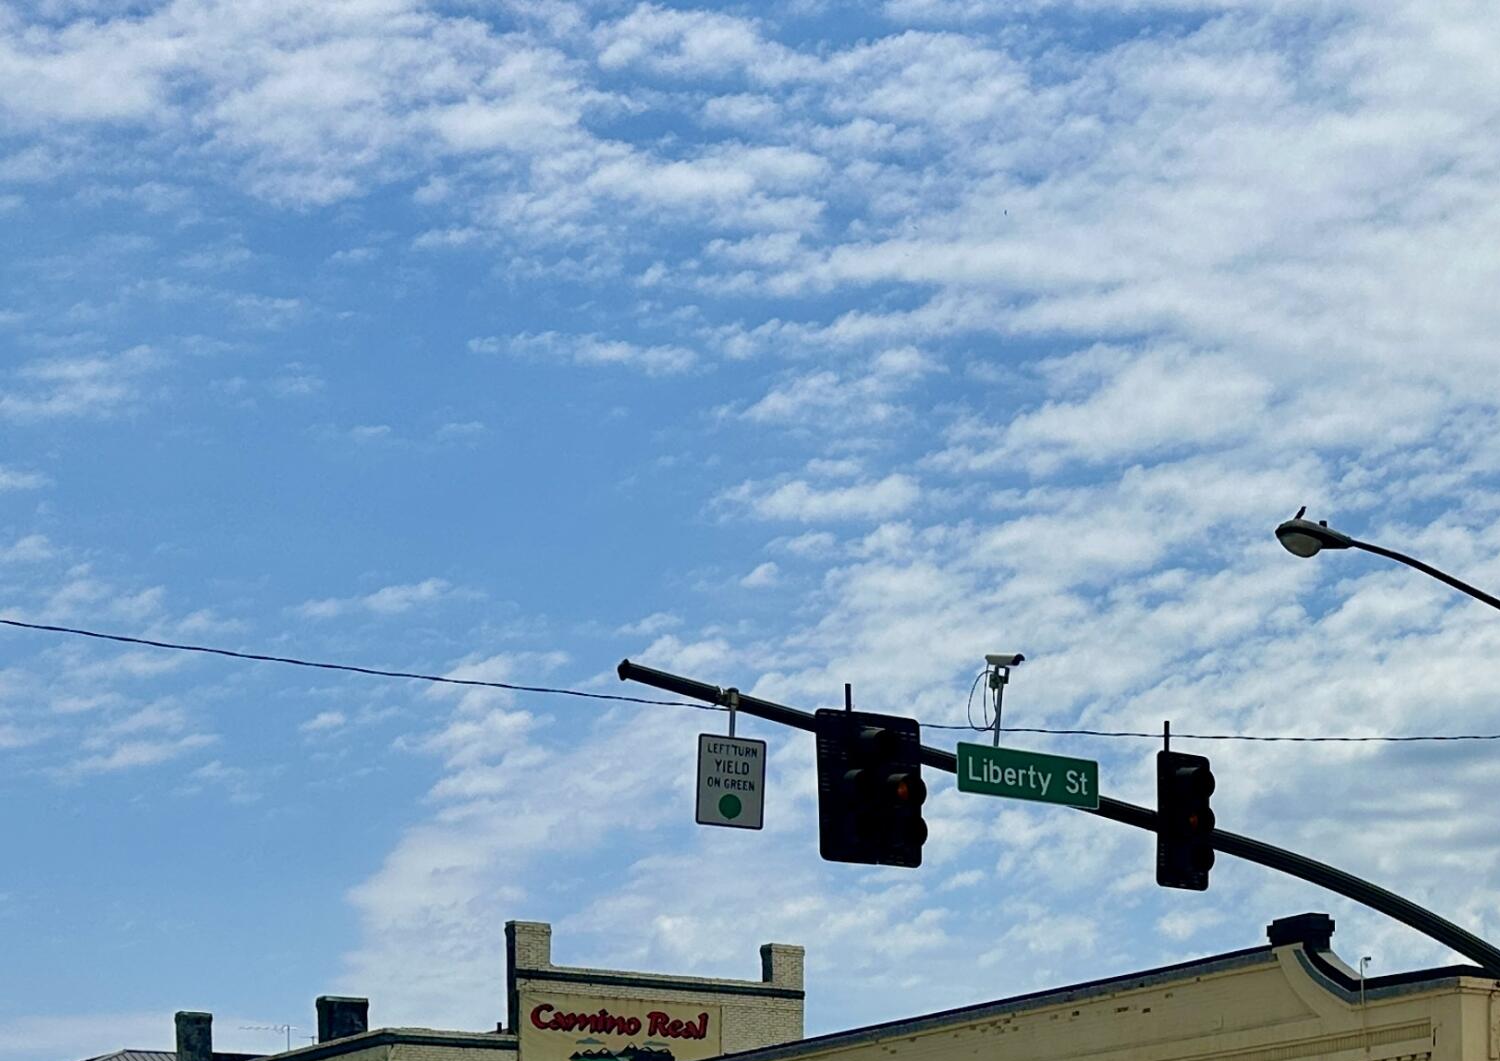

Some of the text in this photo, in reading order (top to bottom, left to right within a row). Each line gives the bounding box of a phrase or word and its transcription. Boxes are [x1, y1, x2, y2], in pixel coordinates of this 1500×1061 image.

[707, 743, 758, 758] LEFT TURN
[714, 759, 750, 776] YIELD
[968, 756, 1089, 796] Liberty St
[707, 776, 755, 791] ON GREEN
[530, 1003, 709, 1040] Camino Real
